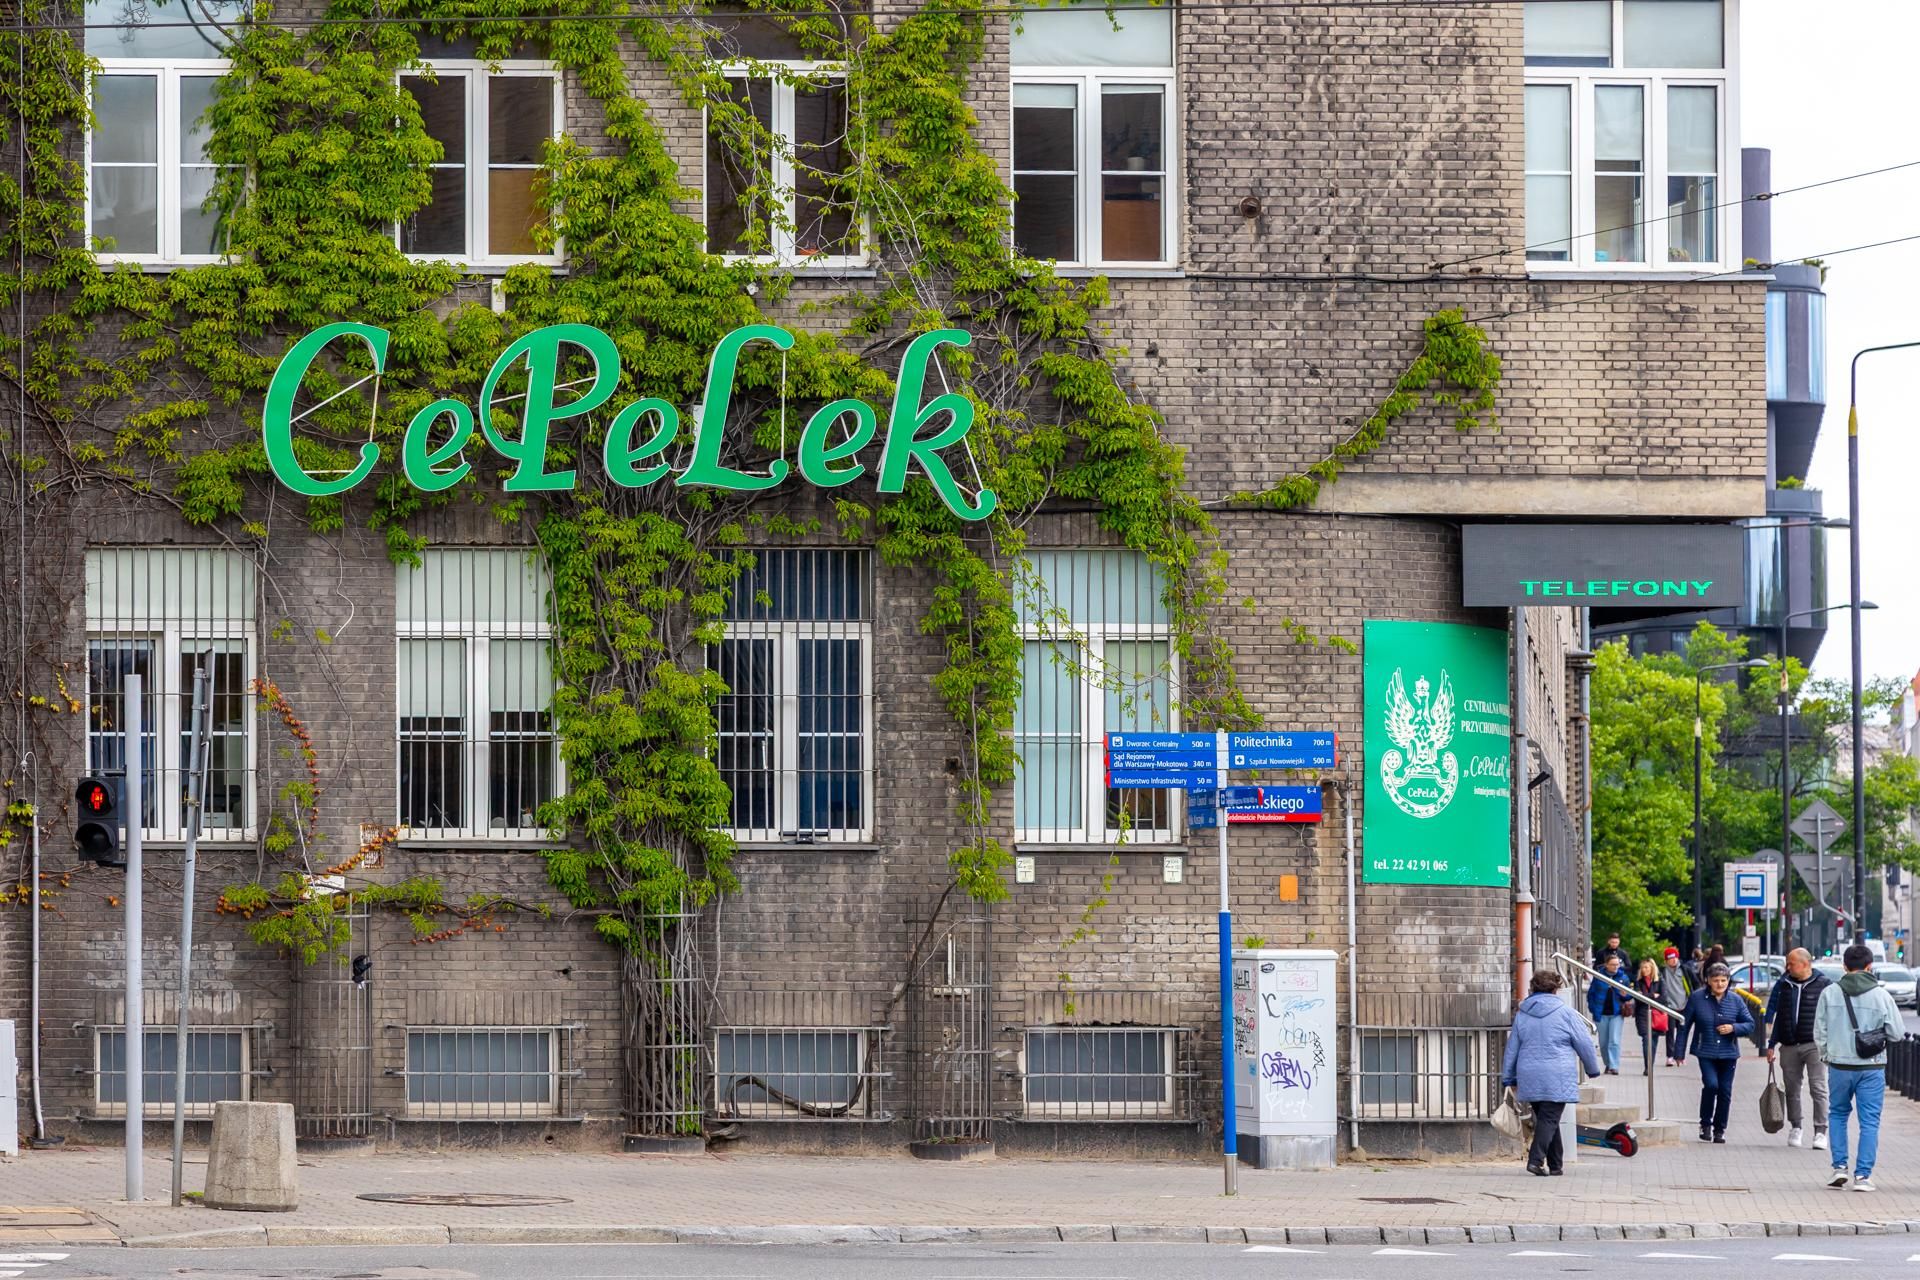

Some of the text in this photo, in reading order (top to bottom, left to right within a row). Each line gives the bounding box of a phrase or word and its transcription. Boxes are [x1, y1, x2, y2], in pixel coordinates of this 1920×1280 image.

[263, 321, 997, 521] CePeLek
[1519, 580, 1713, 596] TELEFONY
[1126, 740, 1150, 748] Dworzec
[1152, 740, 1179, 749] Centralny
[1191, 740, 1204, 748] 500
[1234, 735, 1293, 748] Politechnika
[1113, 753, 1156, 761] Sąd Rejonowy
[1249, 757, 1268, 766] Szpital
[1269, 757, 1306, 766] Nowowiejski
[1312, 757, 1325, 765] 500
[1113, 760, 1124, 768] dla
[1125, 760, 1189, 768] Warszawy-Mokotowa
[1192, 760, 1205, 768] 340
[1114, 777, 1150, 785] Ministerstwo
[1150, 777, 1188, 785] Infrastruktury
[1197, 777, 1205, 785] 50
[1407, 786, 1439, 798] CePeLek
[1373, 858, 1448, 871] tel. 22 42 91 065
